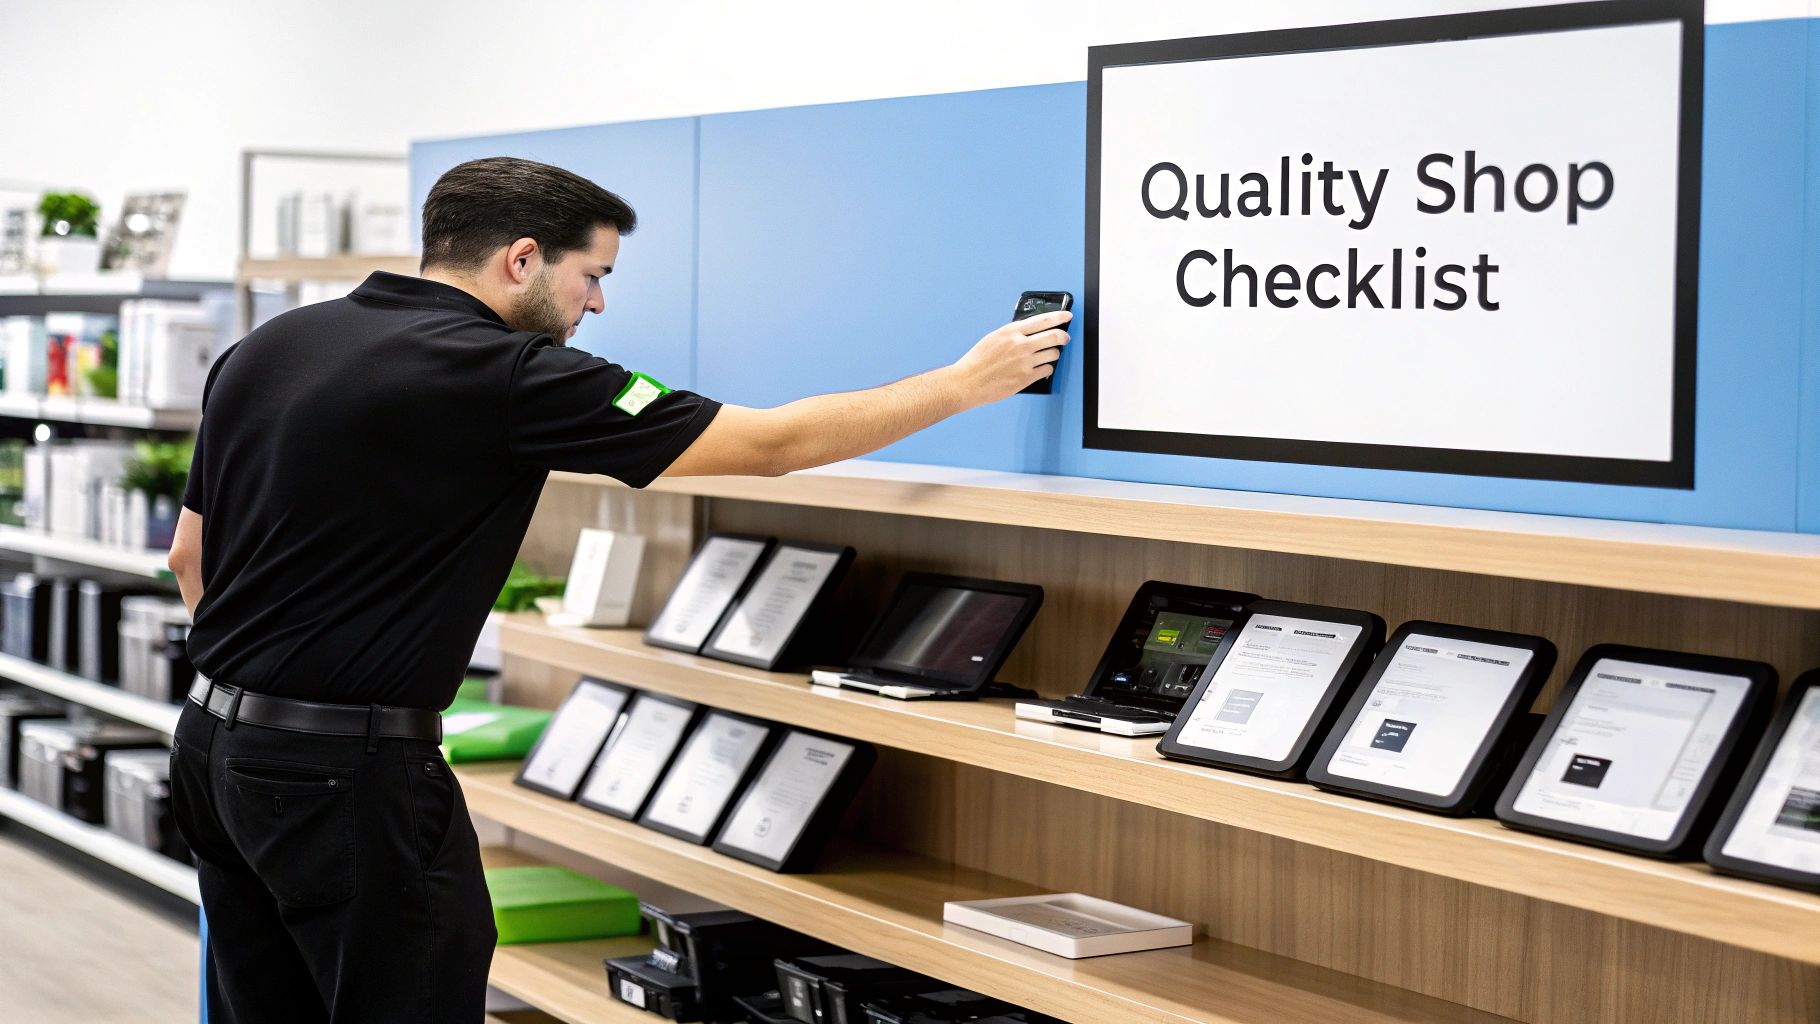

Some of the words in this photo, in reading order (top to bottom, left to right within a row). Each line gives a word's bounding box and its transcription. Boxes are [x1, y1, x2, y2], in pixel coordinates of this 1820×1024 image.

[1141, 152, 1390, 231] Quality
[1416, 150, 1614, 225] Shop
[1176, 246, 1500, 312] Checklist
